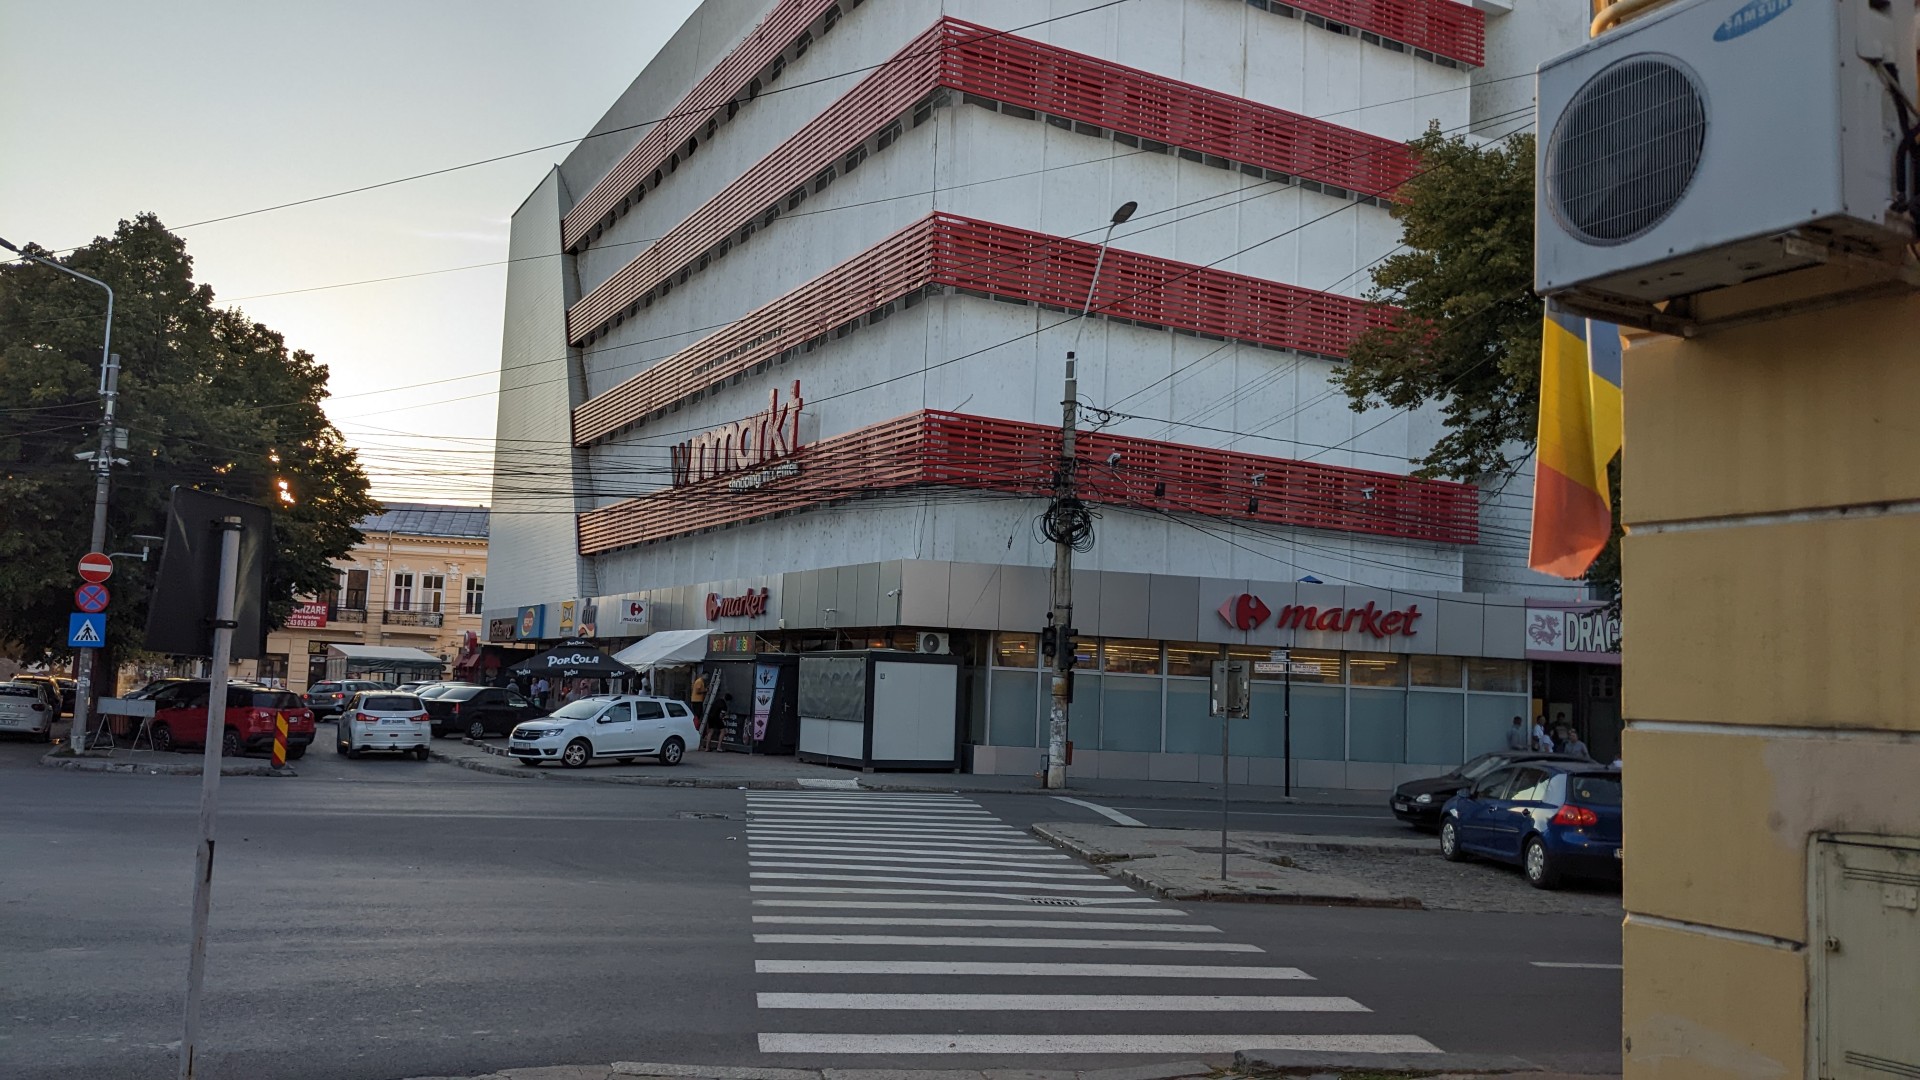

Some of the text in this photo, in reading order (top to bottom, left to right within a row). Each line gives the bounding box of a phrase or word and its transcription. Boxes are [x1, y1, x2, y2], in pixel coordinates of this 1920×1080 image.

[1723, 0, 1792, 31] SAMSUN
[720, 586, 769, 619] market
[1278, 600, 1422, 638] market
[1565, 611, 1622, 654] DRAG
